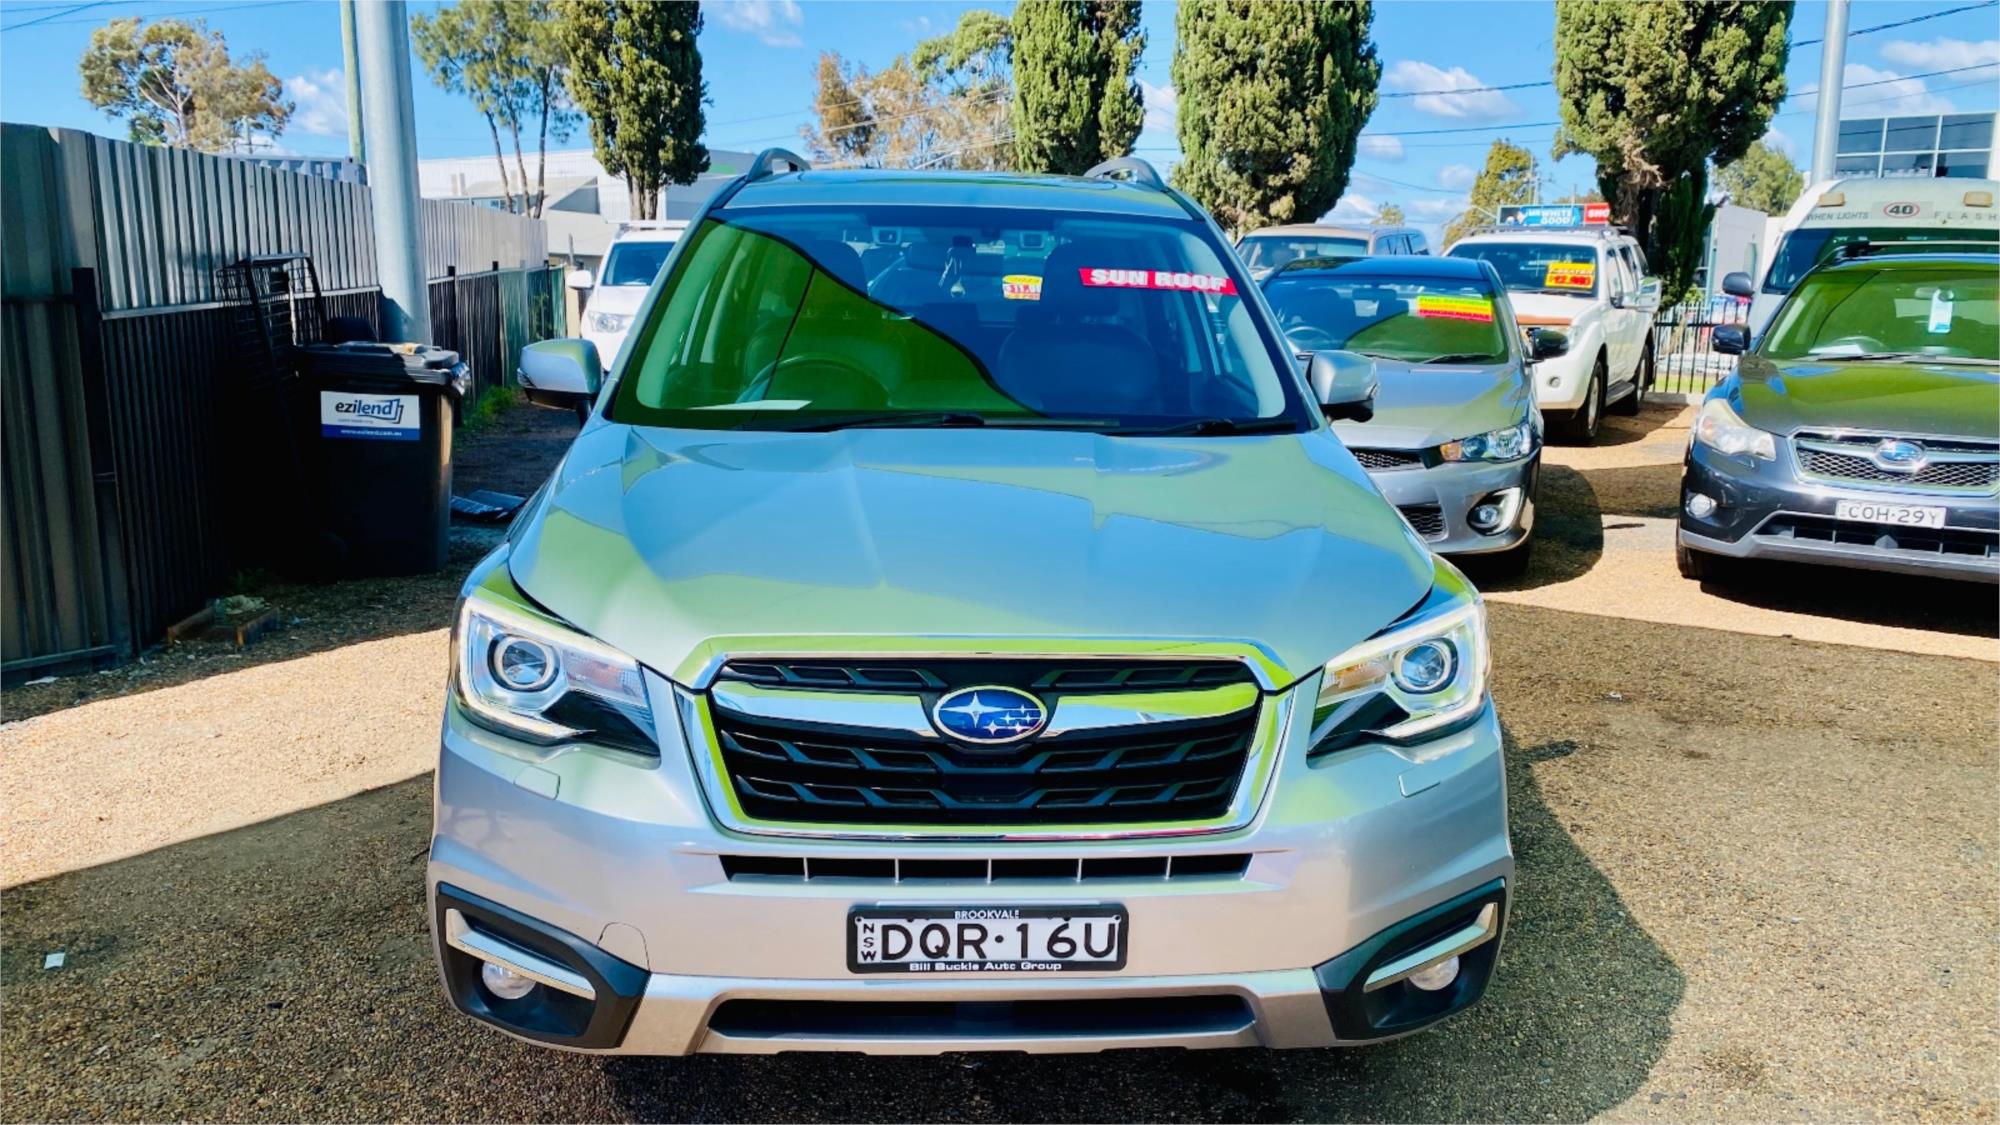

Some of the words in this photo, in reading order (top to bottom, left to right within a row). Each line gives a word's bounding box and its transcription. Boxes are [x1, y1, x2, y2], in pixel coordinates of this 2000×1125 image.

[1807, 211, 1833, 221] WHEN
[1836, 211, 1869, 220] LIGHTS
[1888, 205, 1914, 215] 40
[1934, 211, 1997, 220] FLASH
[1091, 268, 1149, 286] SUN
[1154, 271, 1227, 291] ROOF
[335, 399, 394, 415] ezilend
[954, 910, 1020, 920] BROOKVALE
[861, 923, 876, 961] NSW
[910, 962, 931, 971] Bill
[934, 962, 979, 971] Buckle
[984, 962, 1016, 971] Auto
[1021, 961, 1062, 972] Group
